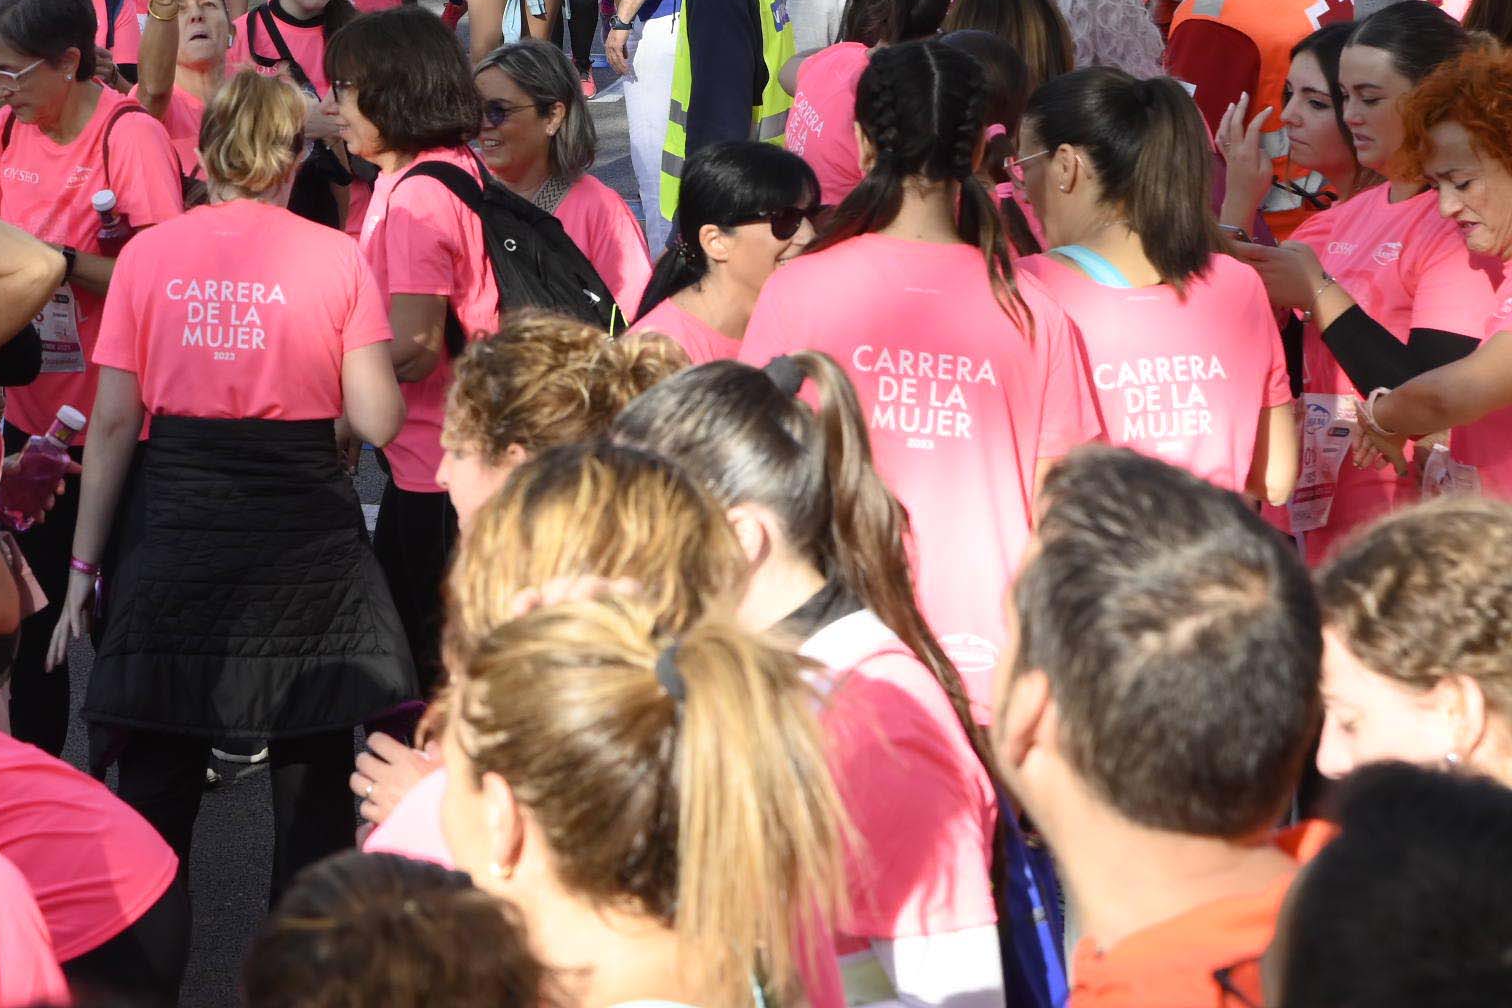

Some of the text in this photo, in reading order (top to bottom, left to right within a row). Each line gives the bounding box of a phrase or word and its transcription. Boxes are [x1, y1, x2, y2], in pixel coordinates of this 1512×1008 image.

[165, 278, 287, 306] CARRERA
[187, 302, 262, 327] DE LA
[181, 325, 268, 351] MUJER
[212, 350, 237, 362] 2023
[851, 344, 997, 387] CARRERA
[1093, 354, 1228, 392] CARRERA
[877, 376, 969, 411] DE LA
[1124, 383, 1208, 414] DE LA
[869, 408, 974, 439] MUJER
[1122, 408, 1214, 441] MUJER
